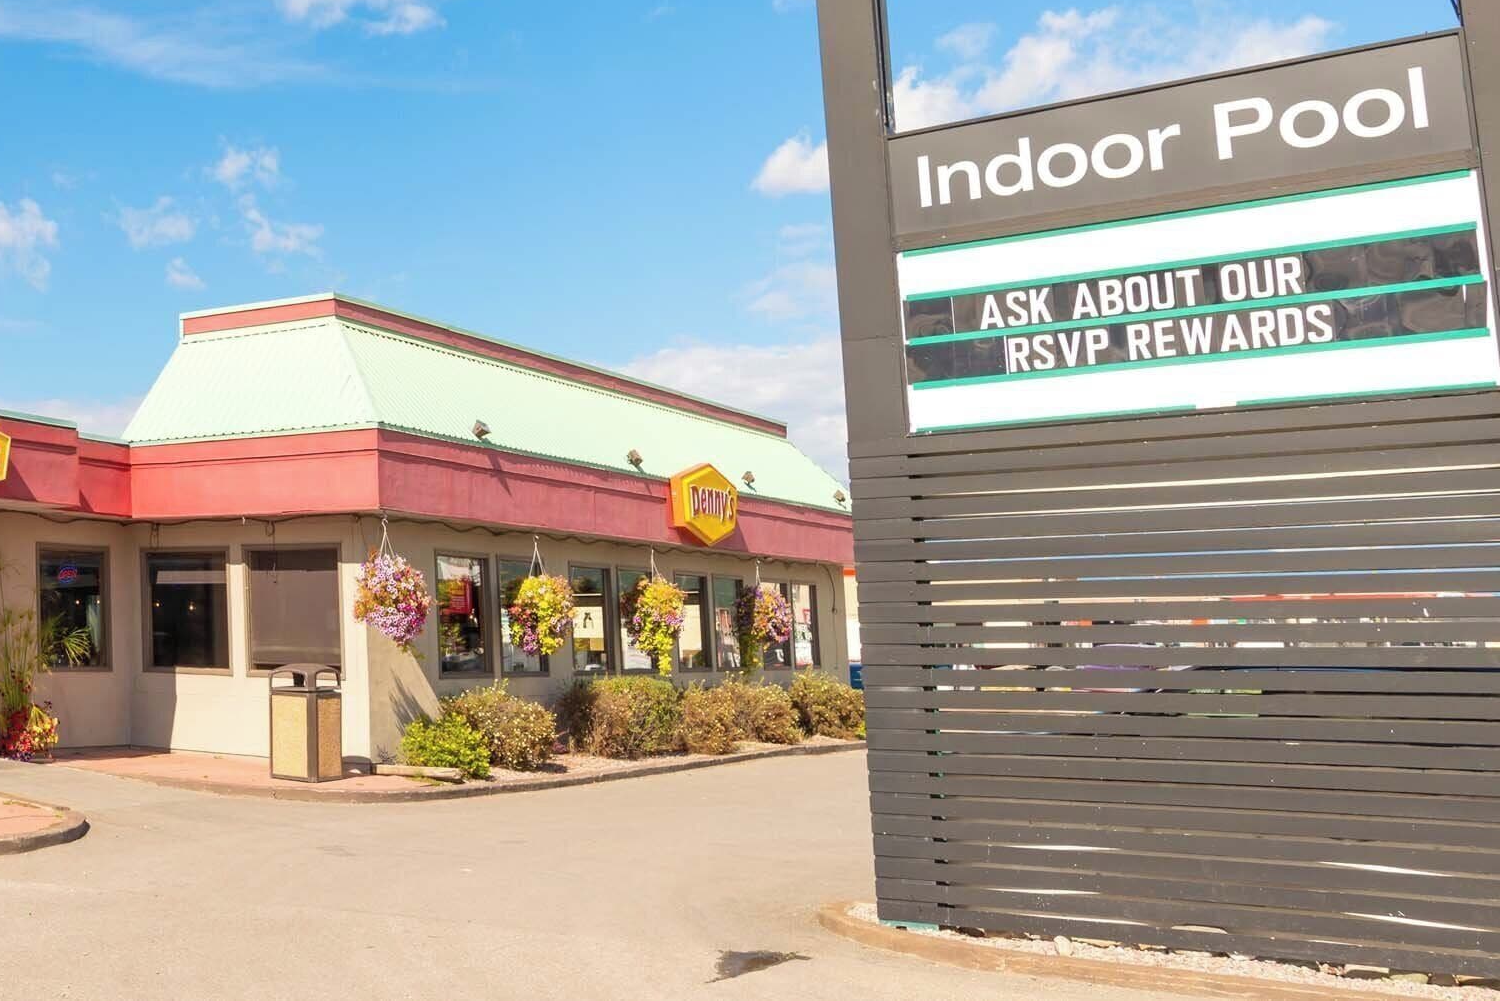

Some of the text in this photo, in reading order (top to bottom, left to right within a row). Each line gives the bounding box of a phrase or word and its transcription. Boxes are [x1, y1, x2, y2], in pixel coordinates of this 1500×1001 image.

[917, 66, 1430, 208] Indoor Pool
[980, 255, 1303, 330] ASK ABOUT OUR
[1008, 304, 1334, 373] RSVP REWARDS
[690, 484, 735, 523] Denny's
